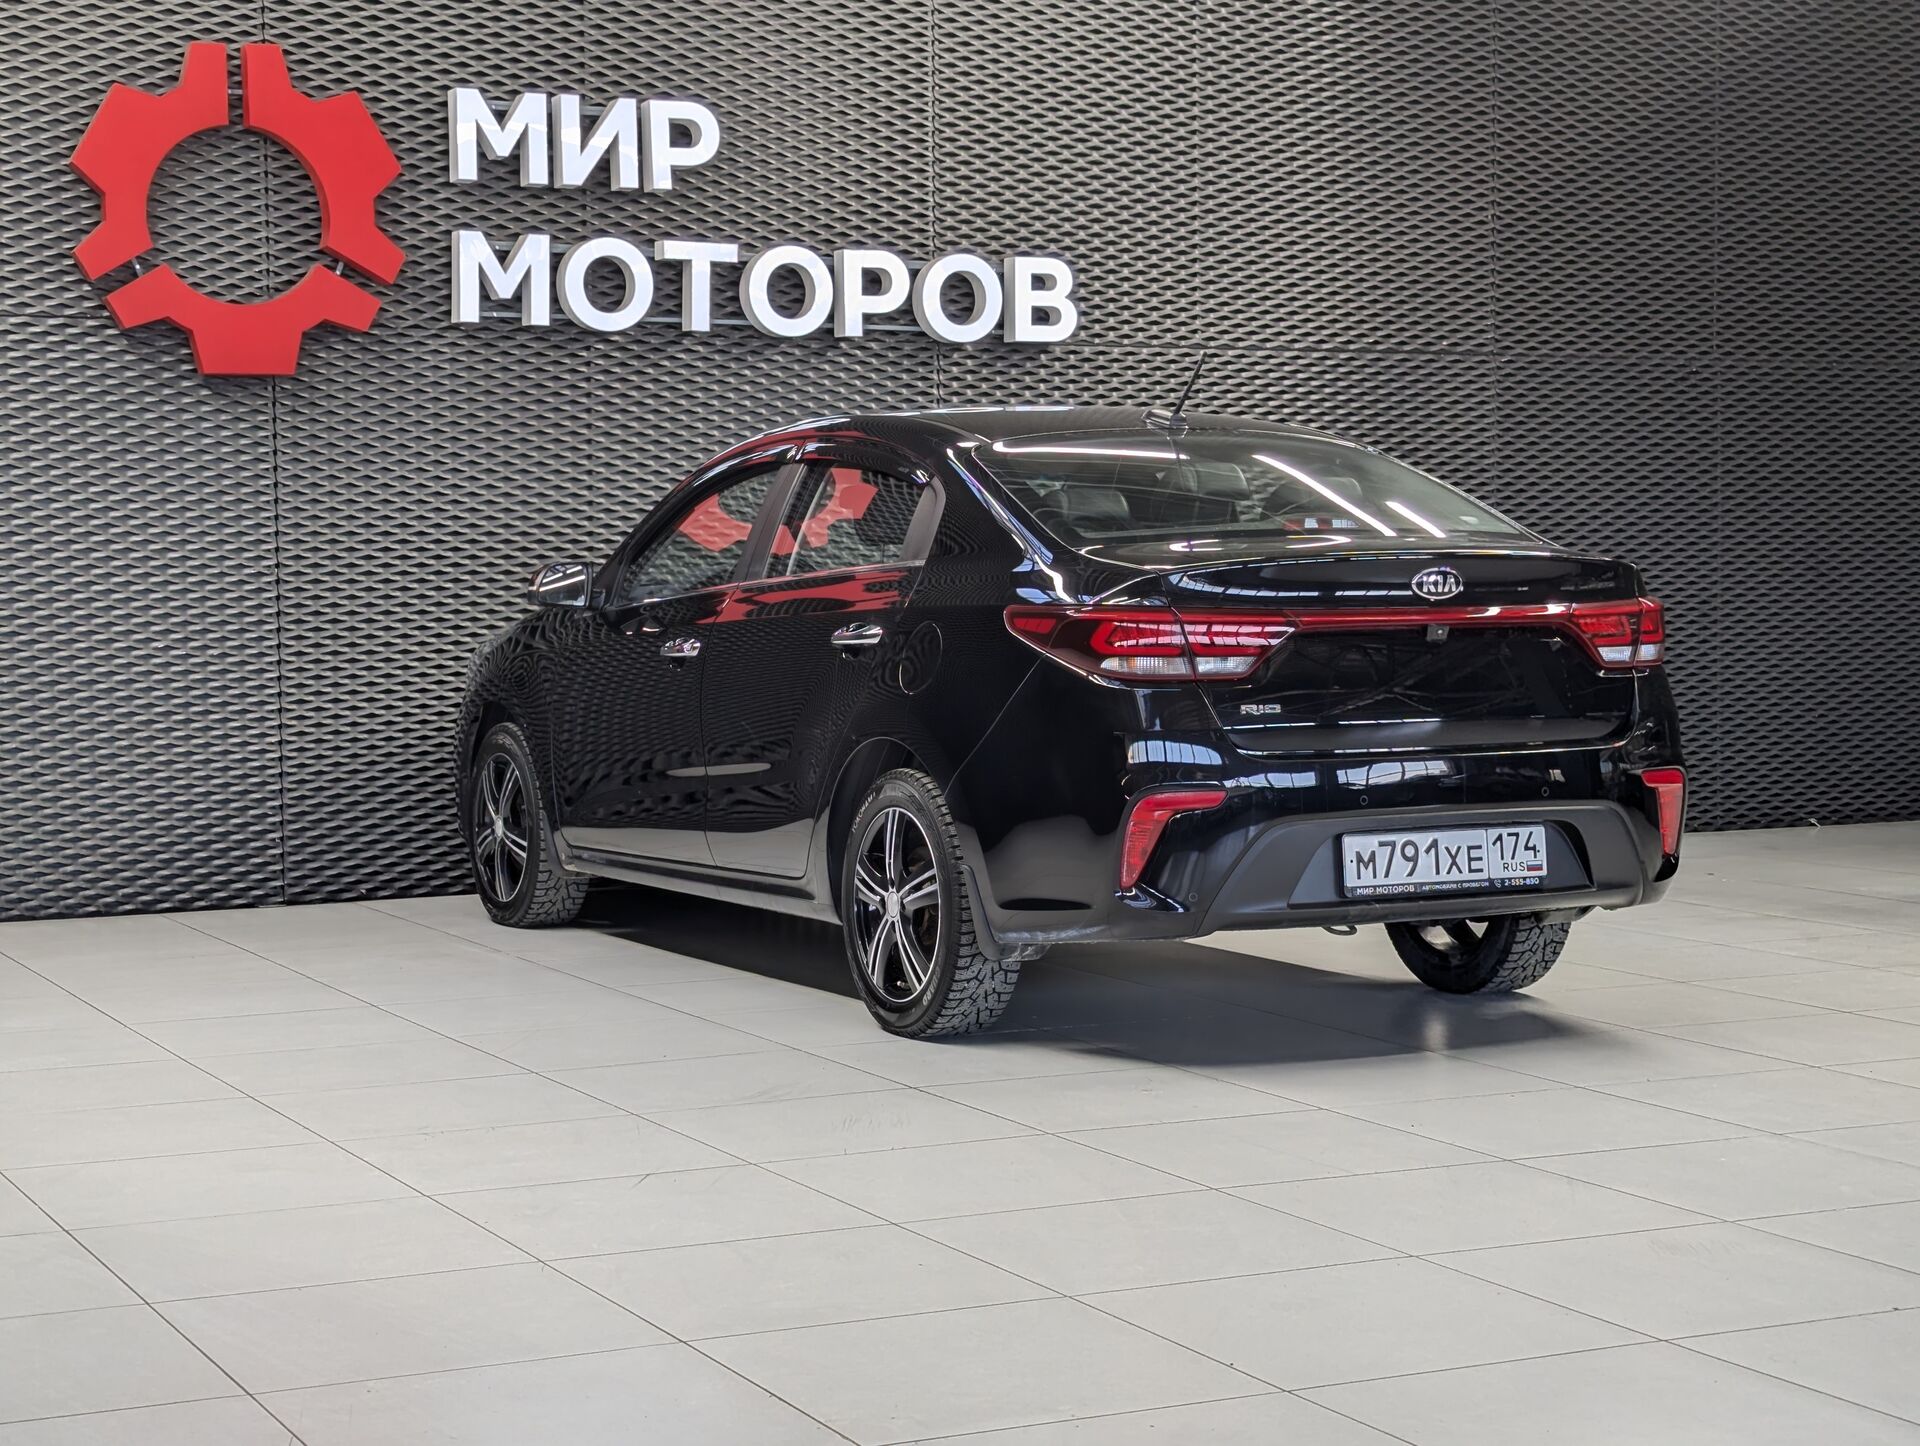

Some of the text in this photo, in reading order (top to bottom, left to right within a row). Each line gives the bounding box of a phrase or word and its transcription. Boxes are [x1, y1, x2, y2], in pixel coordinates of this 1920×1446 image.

[447, 87, 720, 192] МИР
[451, 230, 1079, 343] МОТОРОВ
[1422, 575, 1456, 592] KIA
[1240, 704, 1281, 714] RIO
[1355, 831, 1538, 880] М791ХЕ 174
[1503, 861, 1526, 872] RUS
[1357, 887, 1374, 896] МИР
[1376, 885, 1415, 894] МОТОРОВ
